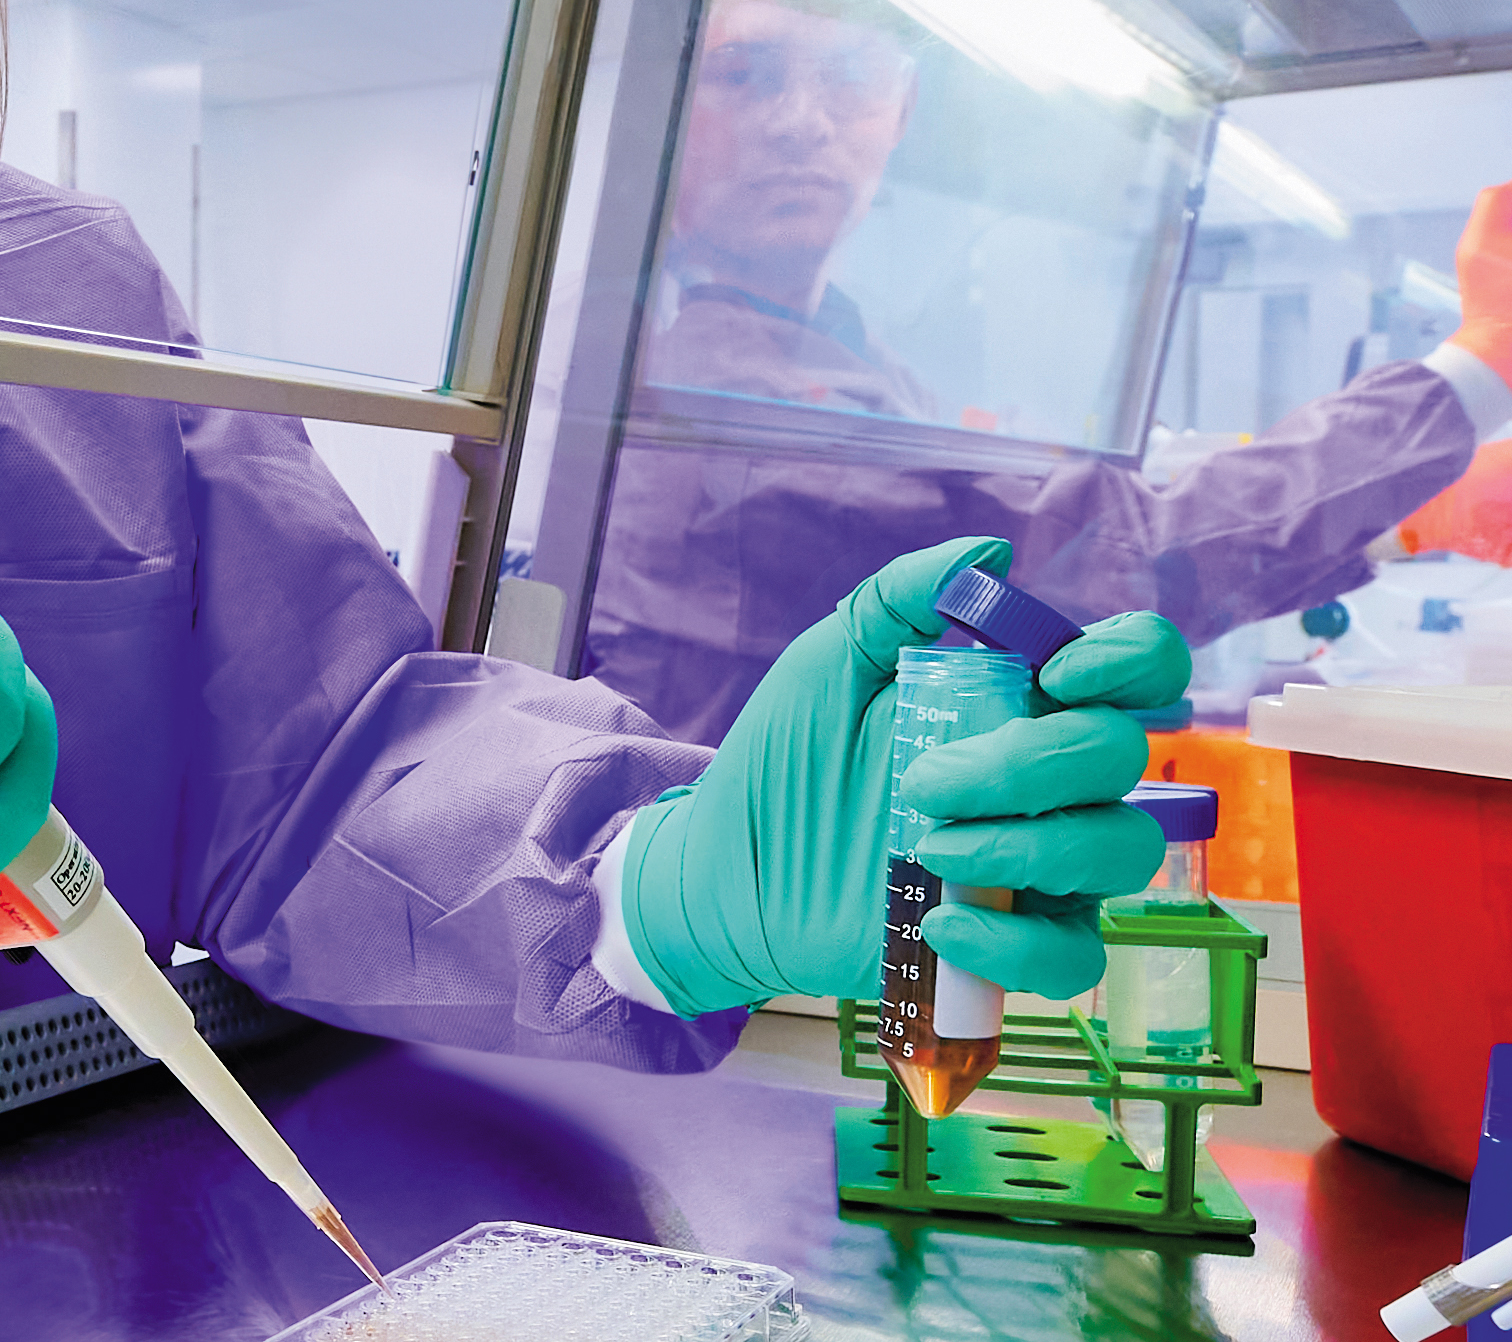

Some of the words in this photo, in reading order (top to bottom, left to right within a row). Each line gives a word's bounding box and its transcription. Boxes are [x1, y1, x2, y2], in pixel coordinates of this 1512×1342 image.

[916, 705, 959, 724] 50ml
[913, 734, 936, 751] 45
[903, 884, 926, 903] 25
[901, 923, 922, 942] 20
[900, 963, 920, 981] 15
[898, 1000, 918, 1019] 10
[884, 1016, 904, 1037] 7.5
[902, 1042, 914, 1059] 5
